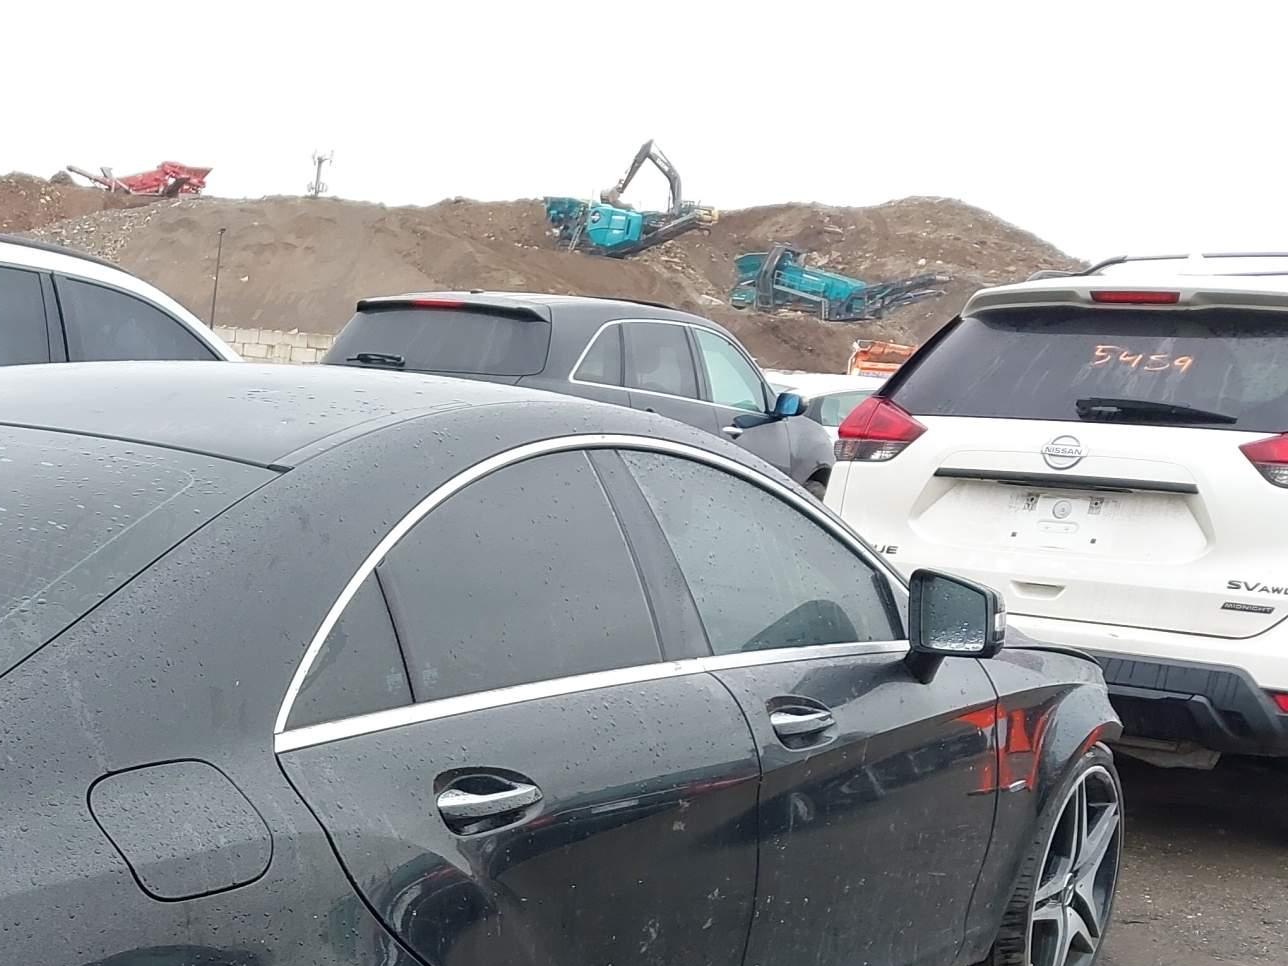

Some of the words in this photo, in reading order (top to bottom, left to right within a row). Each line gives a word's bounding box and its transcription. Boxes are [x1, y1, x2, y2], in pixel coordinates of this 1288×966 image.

[1091, 344, 1194, 374] 5459
[1044, 445, 1083, 456] NISSAN
[1223, 602, 1273, 614] MIDNIGHT
